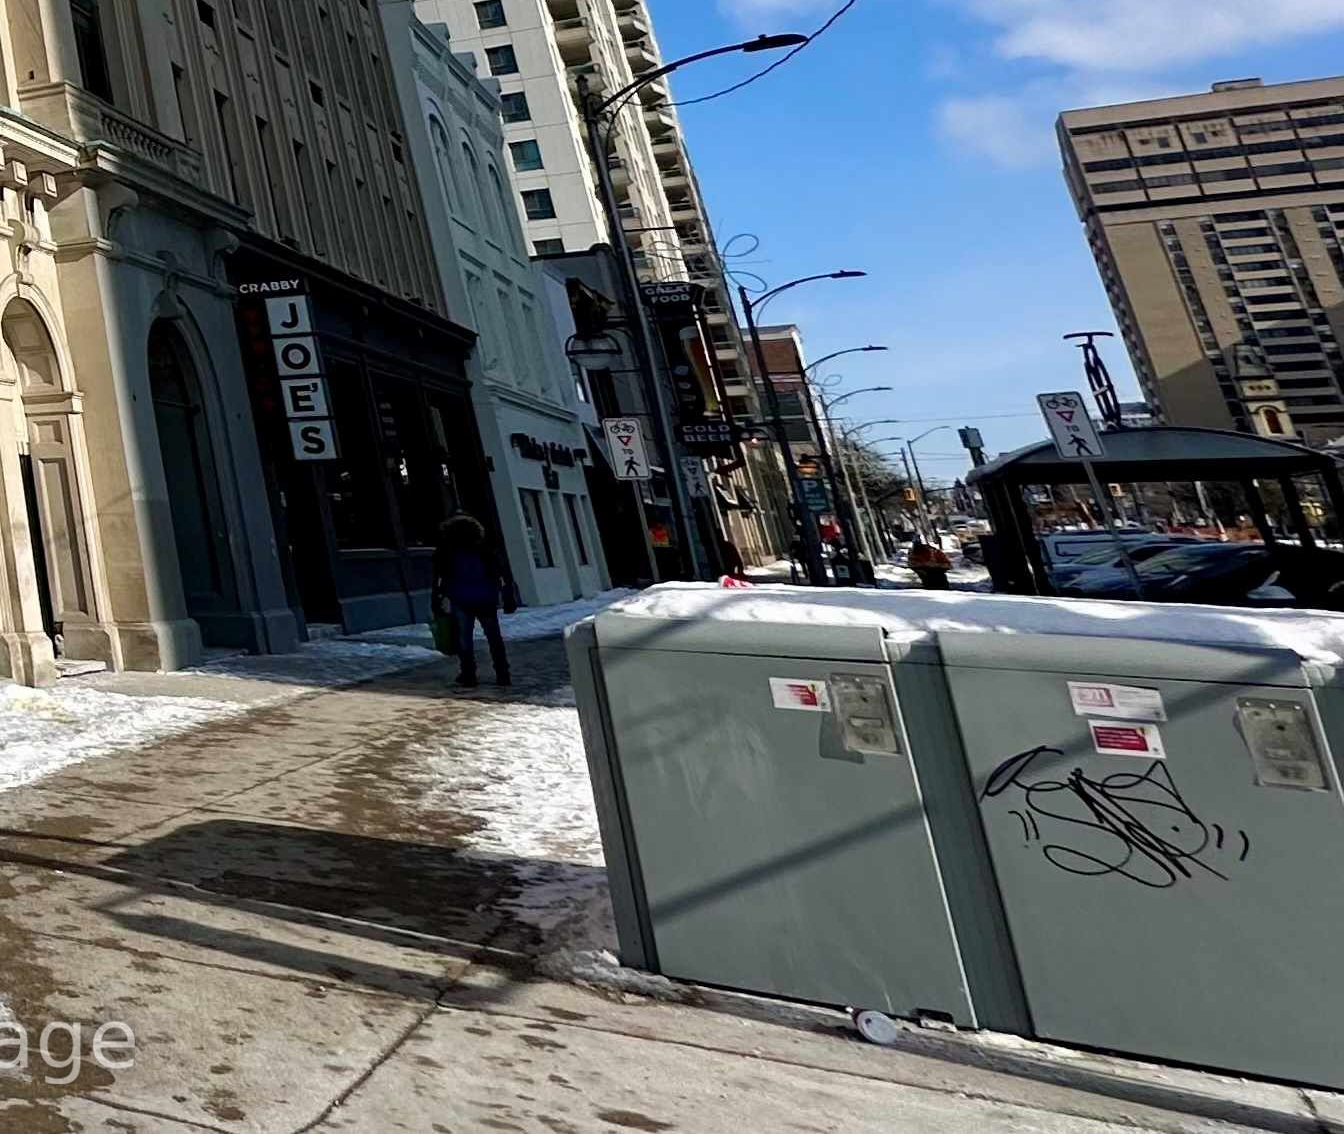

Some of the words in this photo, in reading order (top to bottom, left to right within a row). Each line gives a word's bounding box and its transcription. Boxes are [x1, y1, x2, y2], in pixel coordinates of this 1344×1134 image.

[239, 279, 300, 294] CRABBY
[650, 293, 690, 304] FOOD
[280, 302, 326, 455] JOE'S
[682, 424, 731, 433] COLD
[683, 434, 732, 442] BEER
[621, 448, 634, 456] TO
